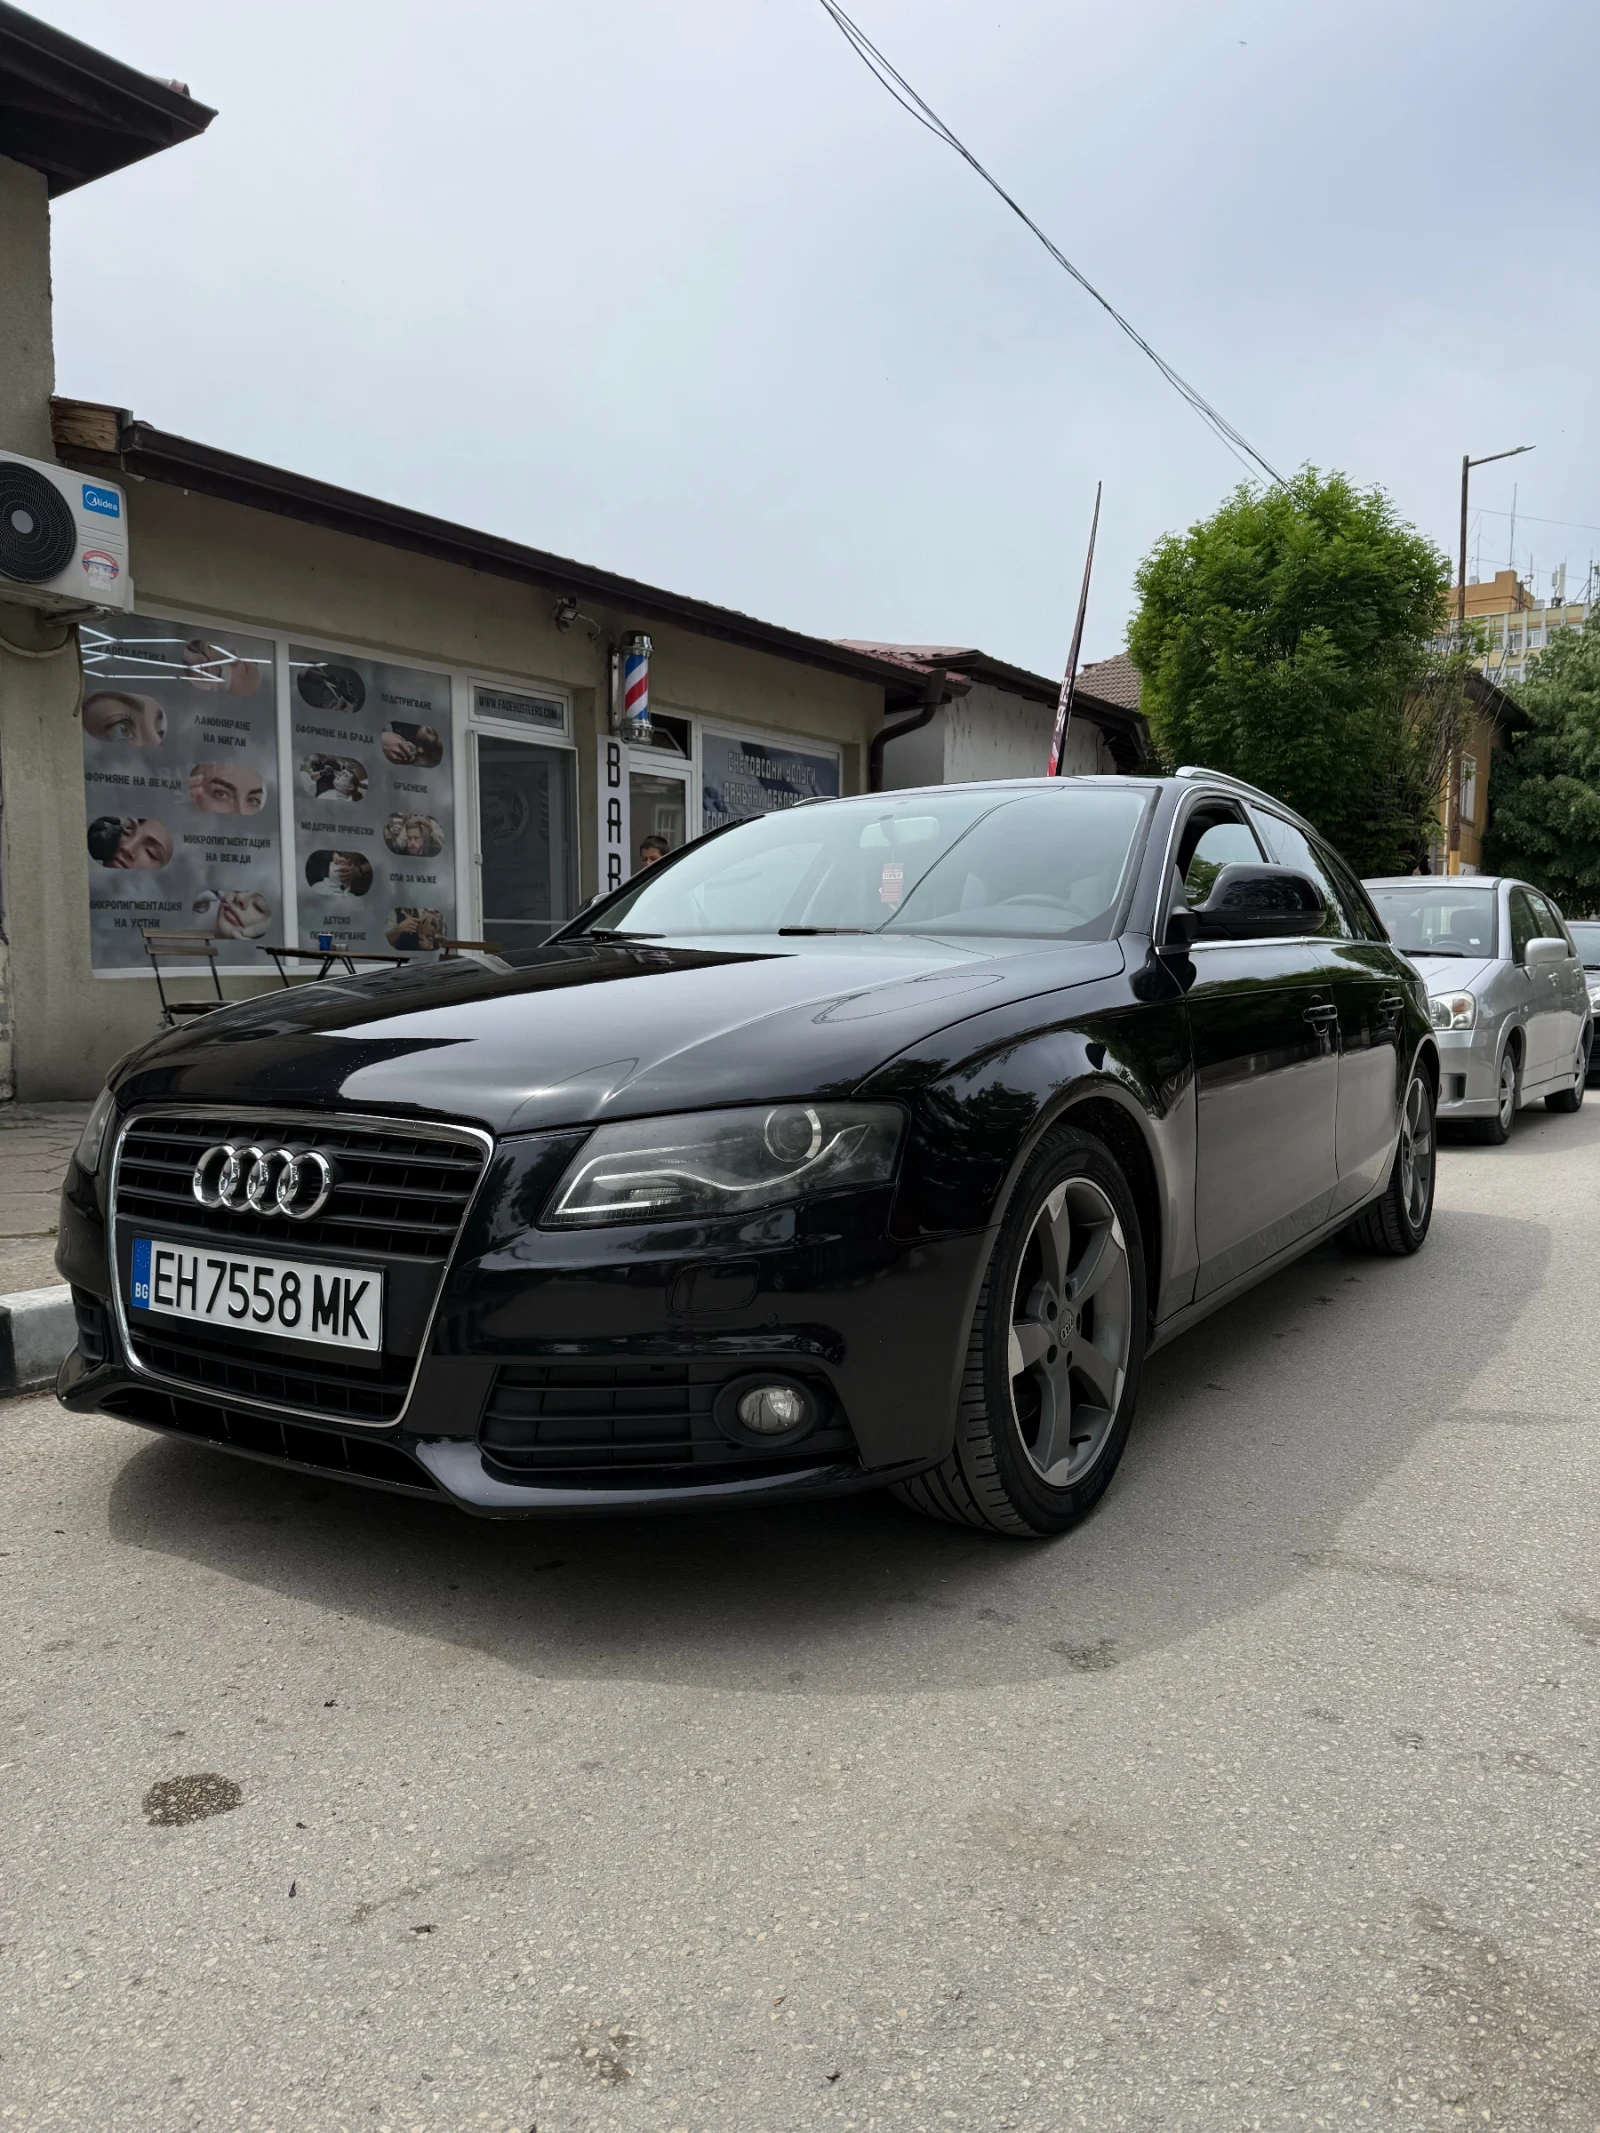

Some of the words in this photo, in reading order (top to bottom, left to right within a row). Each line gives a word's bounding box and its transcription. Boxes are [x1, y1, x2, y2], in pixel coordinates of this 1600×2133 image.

[85, 491, 118, 511] Midea
[381, 693, 432, 710] ПОДСТРИГВАНЕ
[194, 715, 252, 731] ЛАМИНИРАНЕ
[203, 734, 216, 744] НА
[217, 735, 247, 747] МИГЛИ
[295, 724, 336, 738] ОФОРМЯНЕ
[337, 731, 348, 740] НА
[349, 732, 375, 744] БРАДА
[786, 762, 816, 785] УСЛУГИ
[84, 773, 130, 786] ФОРМЯНЕ
[133, 776, 146, 787] НА
[149, 778, 182, 790] ВЕЖДИ
[393, 782, 428, 793] БРЪСНЕНЕ
[724, 781, 764, 808] ДАНЪЧНИ
[301, 821, 336, 833] МОДЕРНИ
[338, 825, 374, 836] ПРИЧЕСКИ
[183, 834, 271, 849] МИКРОПИГМЕНТАЦИЯ
[205, 853, 217, 862] НА
[220, 853, 251, 864] ВЕЖДИ
[390, 873, 404, 882] СПА
[416, 875, 437, 884] МЪЖЕ
[114, 918, 127, 928] НА
[131, 918, 160, 928] УСТНИ
[323, 915, 351, 925] ДЕТСКО
[134, 1281, 150, 1300] BG
[154, 1250, 198, 1311] EH
[205, 1258, 302, 1328] 7558
[311, 1273, 371, 1340] MK
